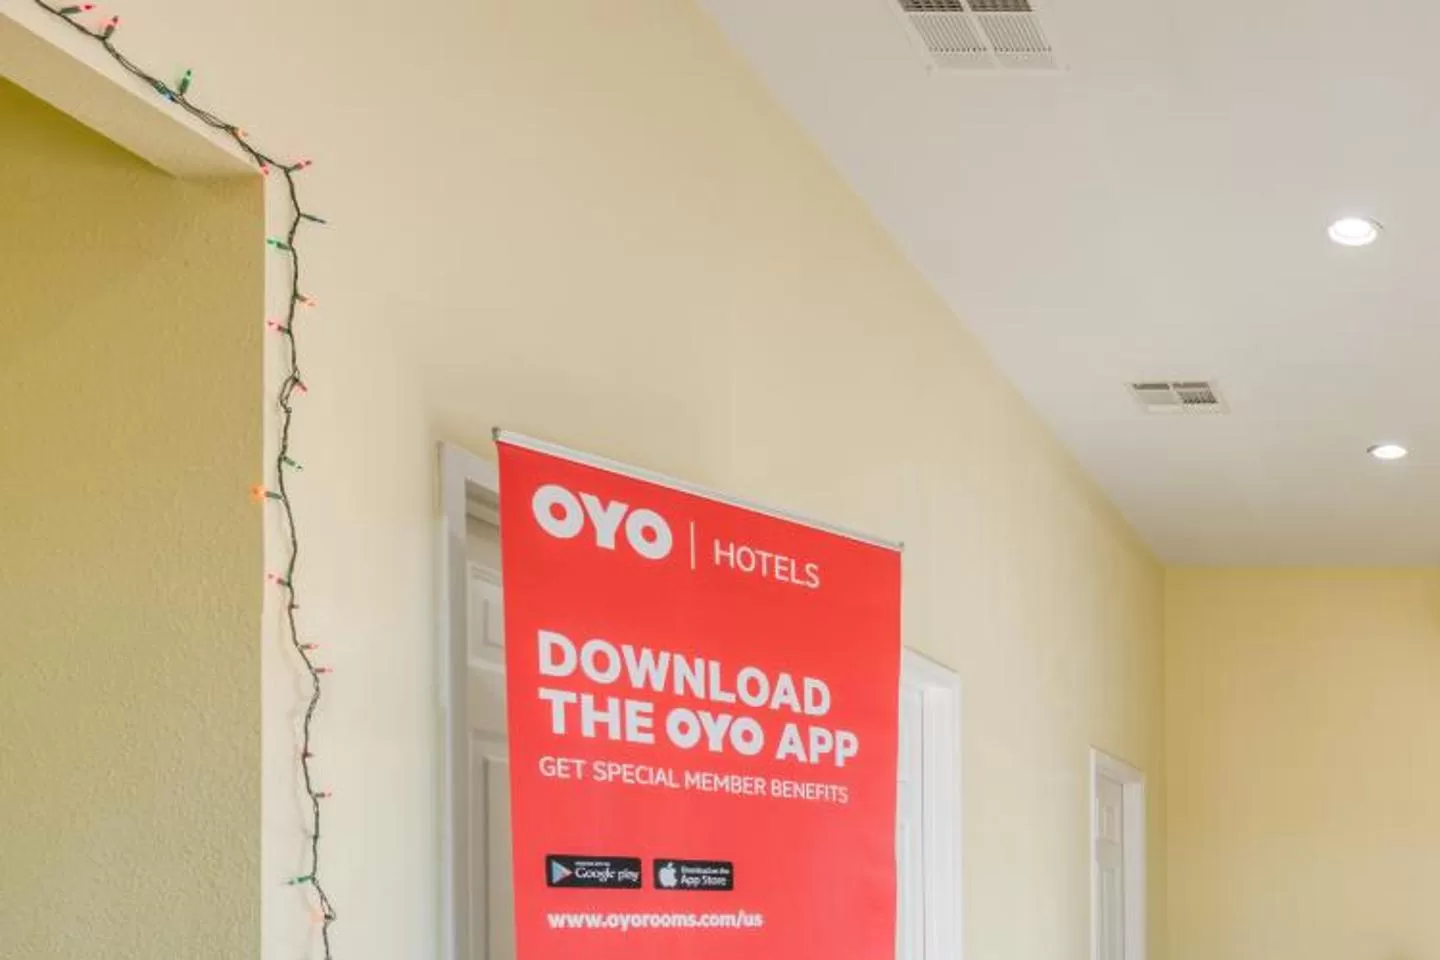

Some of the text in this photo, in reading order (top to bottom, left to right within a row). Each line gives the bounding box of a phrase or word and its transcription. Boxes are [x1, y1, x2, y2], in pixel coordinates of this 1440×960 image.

[532, 484, 821, 589] OYO HOTELS
[537, 629, 832, 716] DOWNLOAD
[538, 687, 859, 768] THE OYO APP
[538, 755, 849, 804] GET SPECIAL MEMBER BENEFITS
[575, 867, 616, 883] Google
[681, 874, 727, 888] App Store
[547, 908, 764, 932] www.oyorooms.com/us
